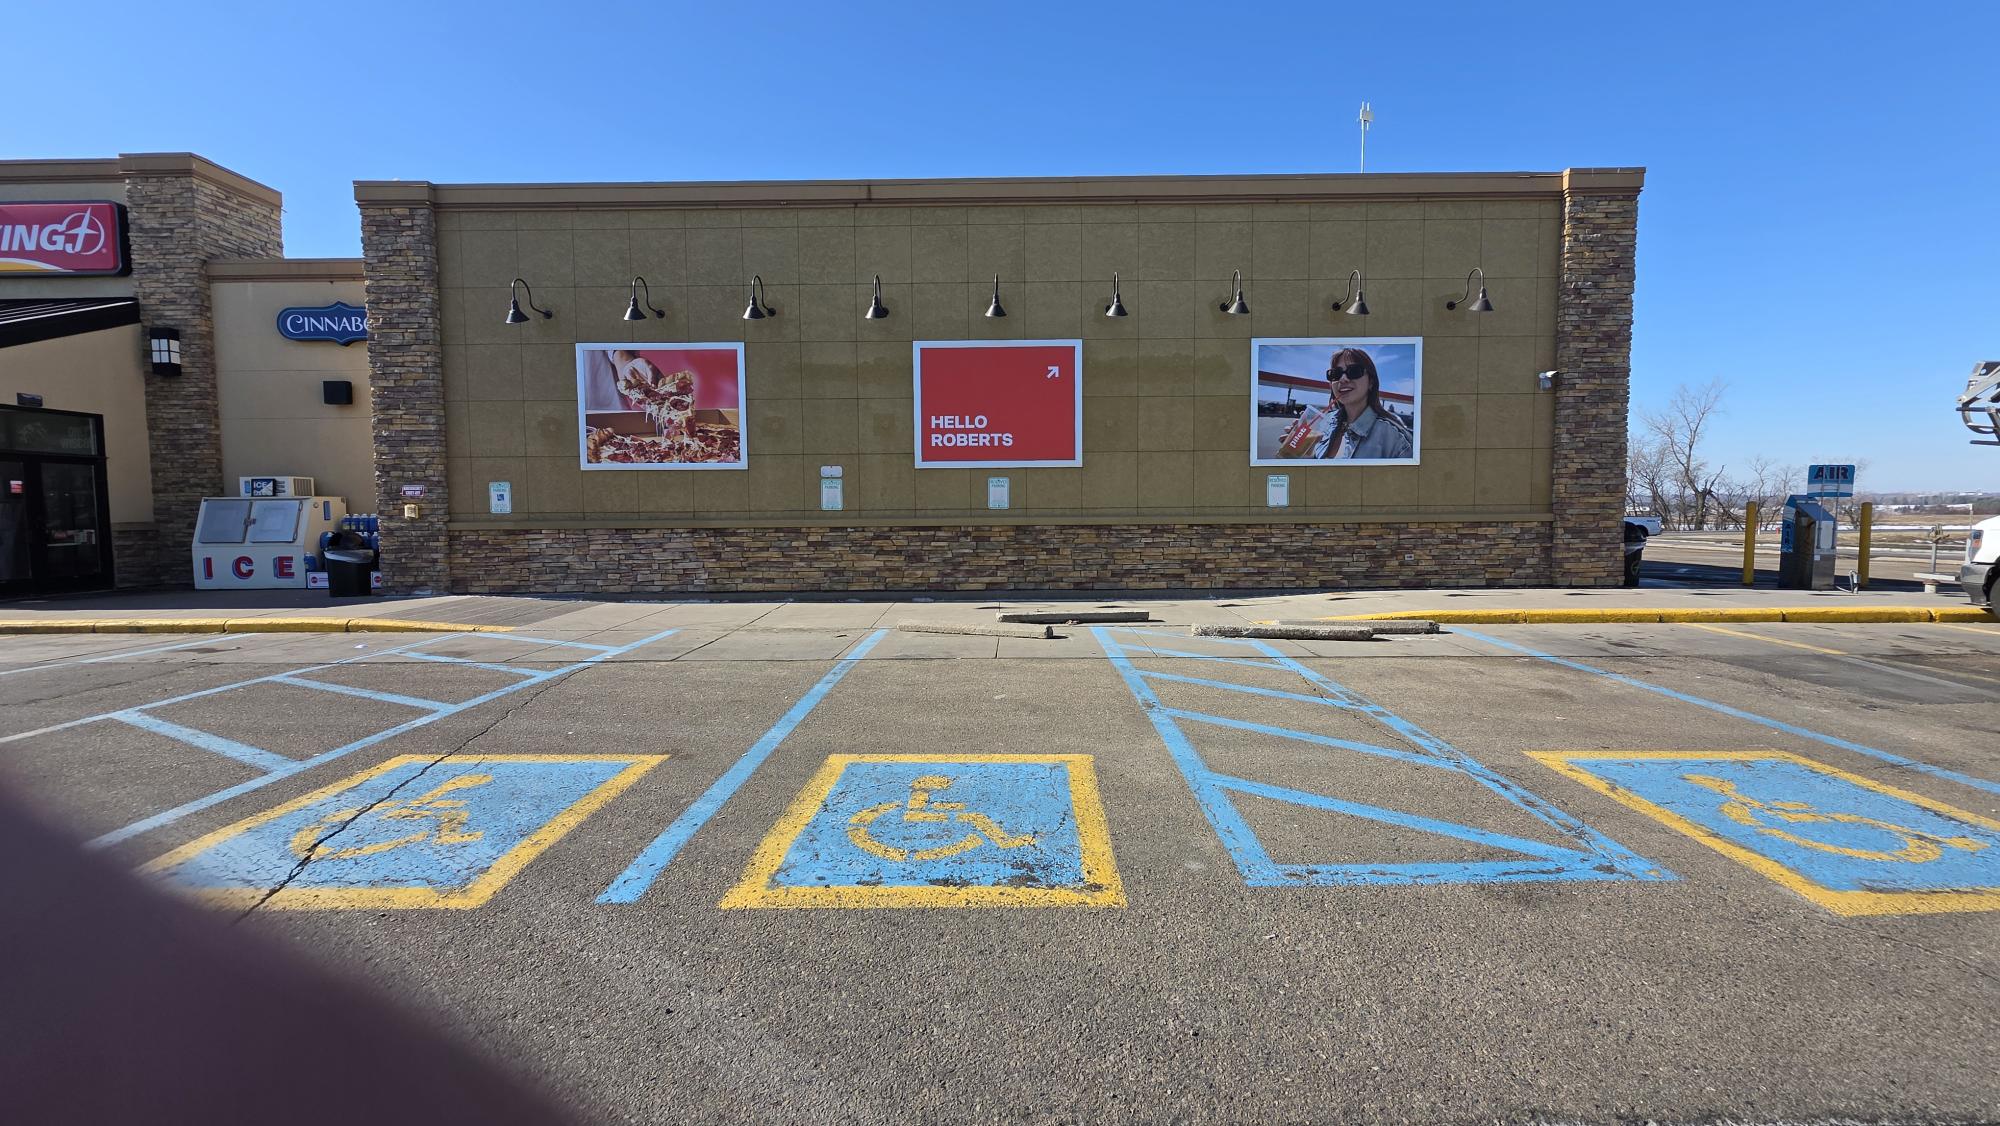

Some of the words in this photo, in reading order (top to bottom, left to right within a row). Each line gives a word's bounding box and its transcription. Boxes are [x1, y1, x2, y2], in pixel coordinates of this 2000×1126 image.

[931, 415, 988, 429] HELLO
[931, 433, 1014, 447] ROBERTS
[1290, 427, 1307, 448] pilot
[1813, 466, 1849, 480] AIR
[253, 481, 268, 489] ICE
[203, 556, 295, 580] ICE
